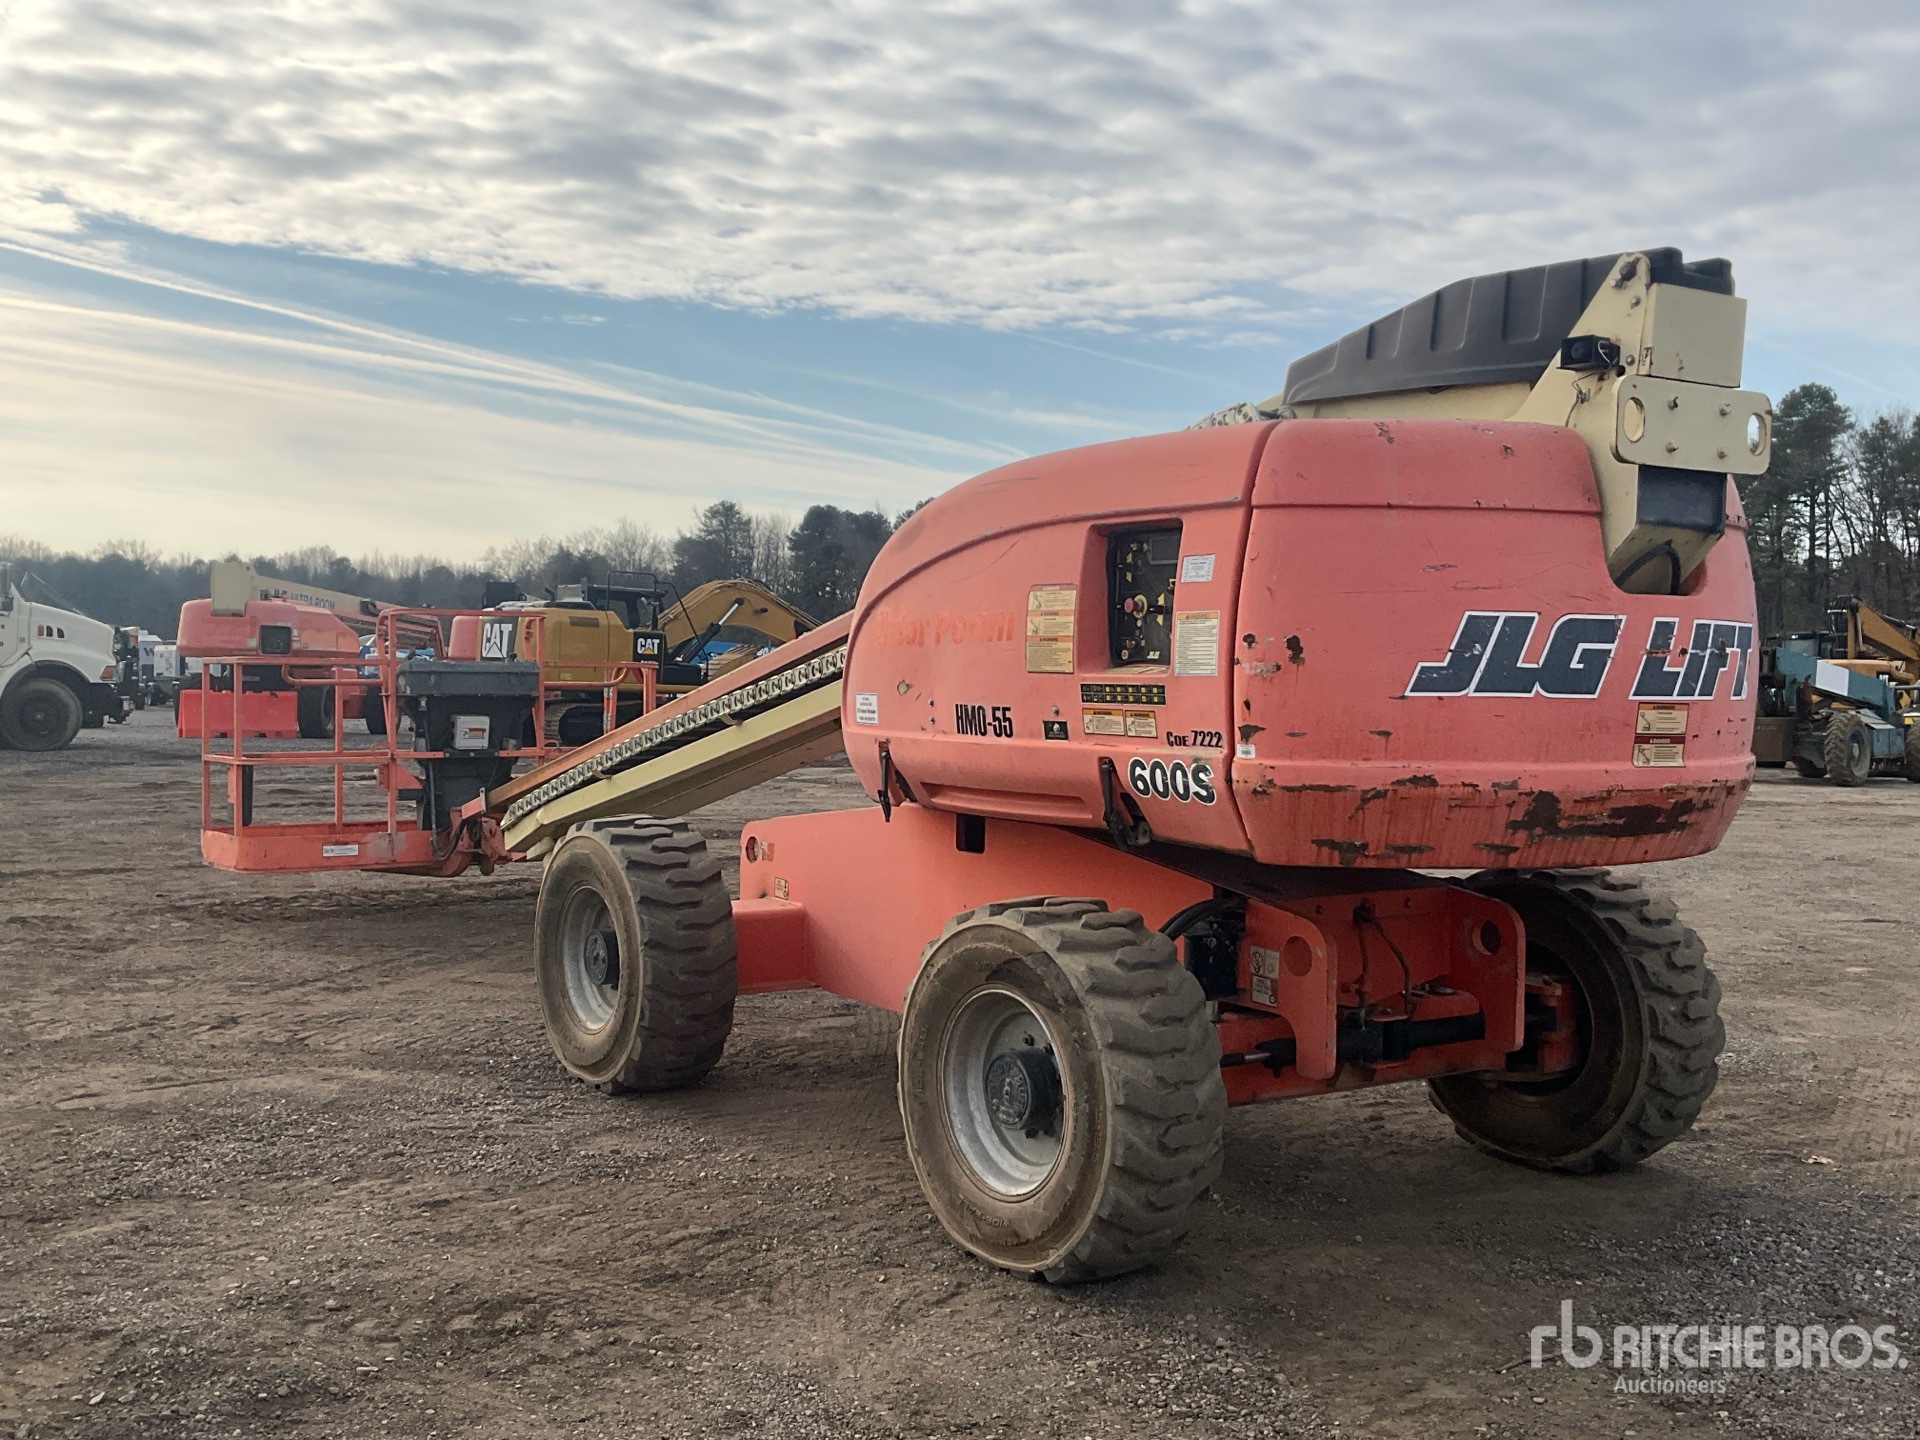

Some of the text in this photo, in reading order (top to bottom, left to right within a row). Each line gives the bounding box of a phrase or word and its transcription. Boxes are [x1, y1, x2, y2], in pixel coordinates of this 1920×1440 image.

[482, 623, 513, 658] CAT
[637, 638, 660, 655] CAT
[1404, 610, 1753, 700] JLG LIFT
[955, 703, 1013, 738] HMO-55
[1191, 730, 1223, 748] 7222
[1128, 757, 1217, 806] 600S
